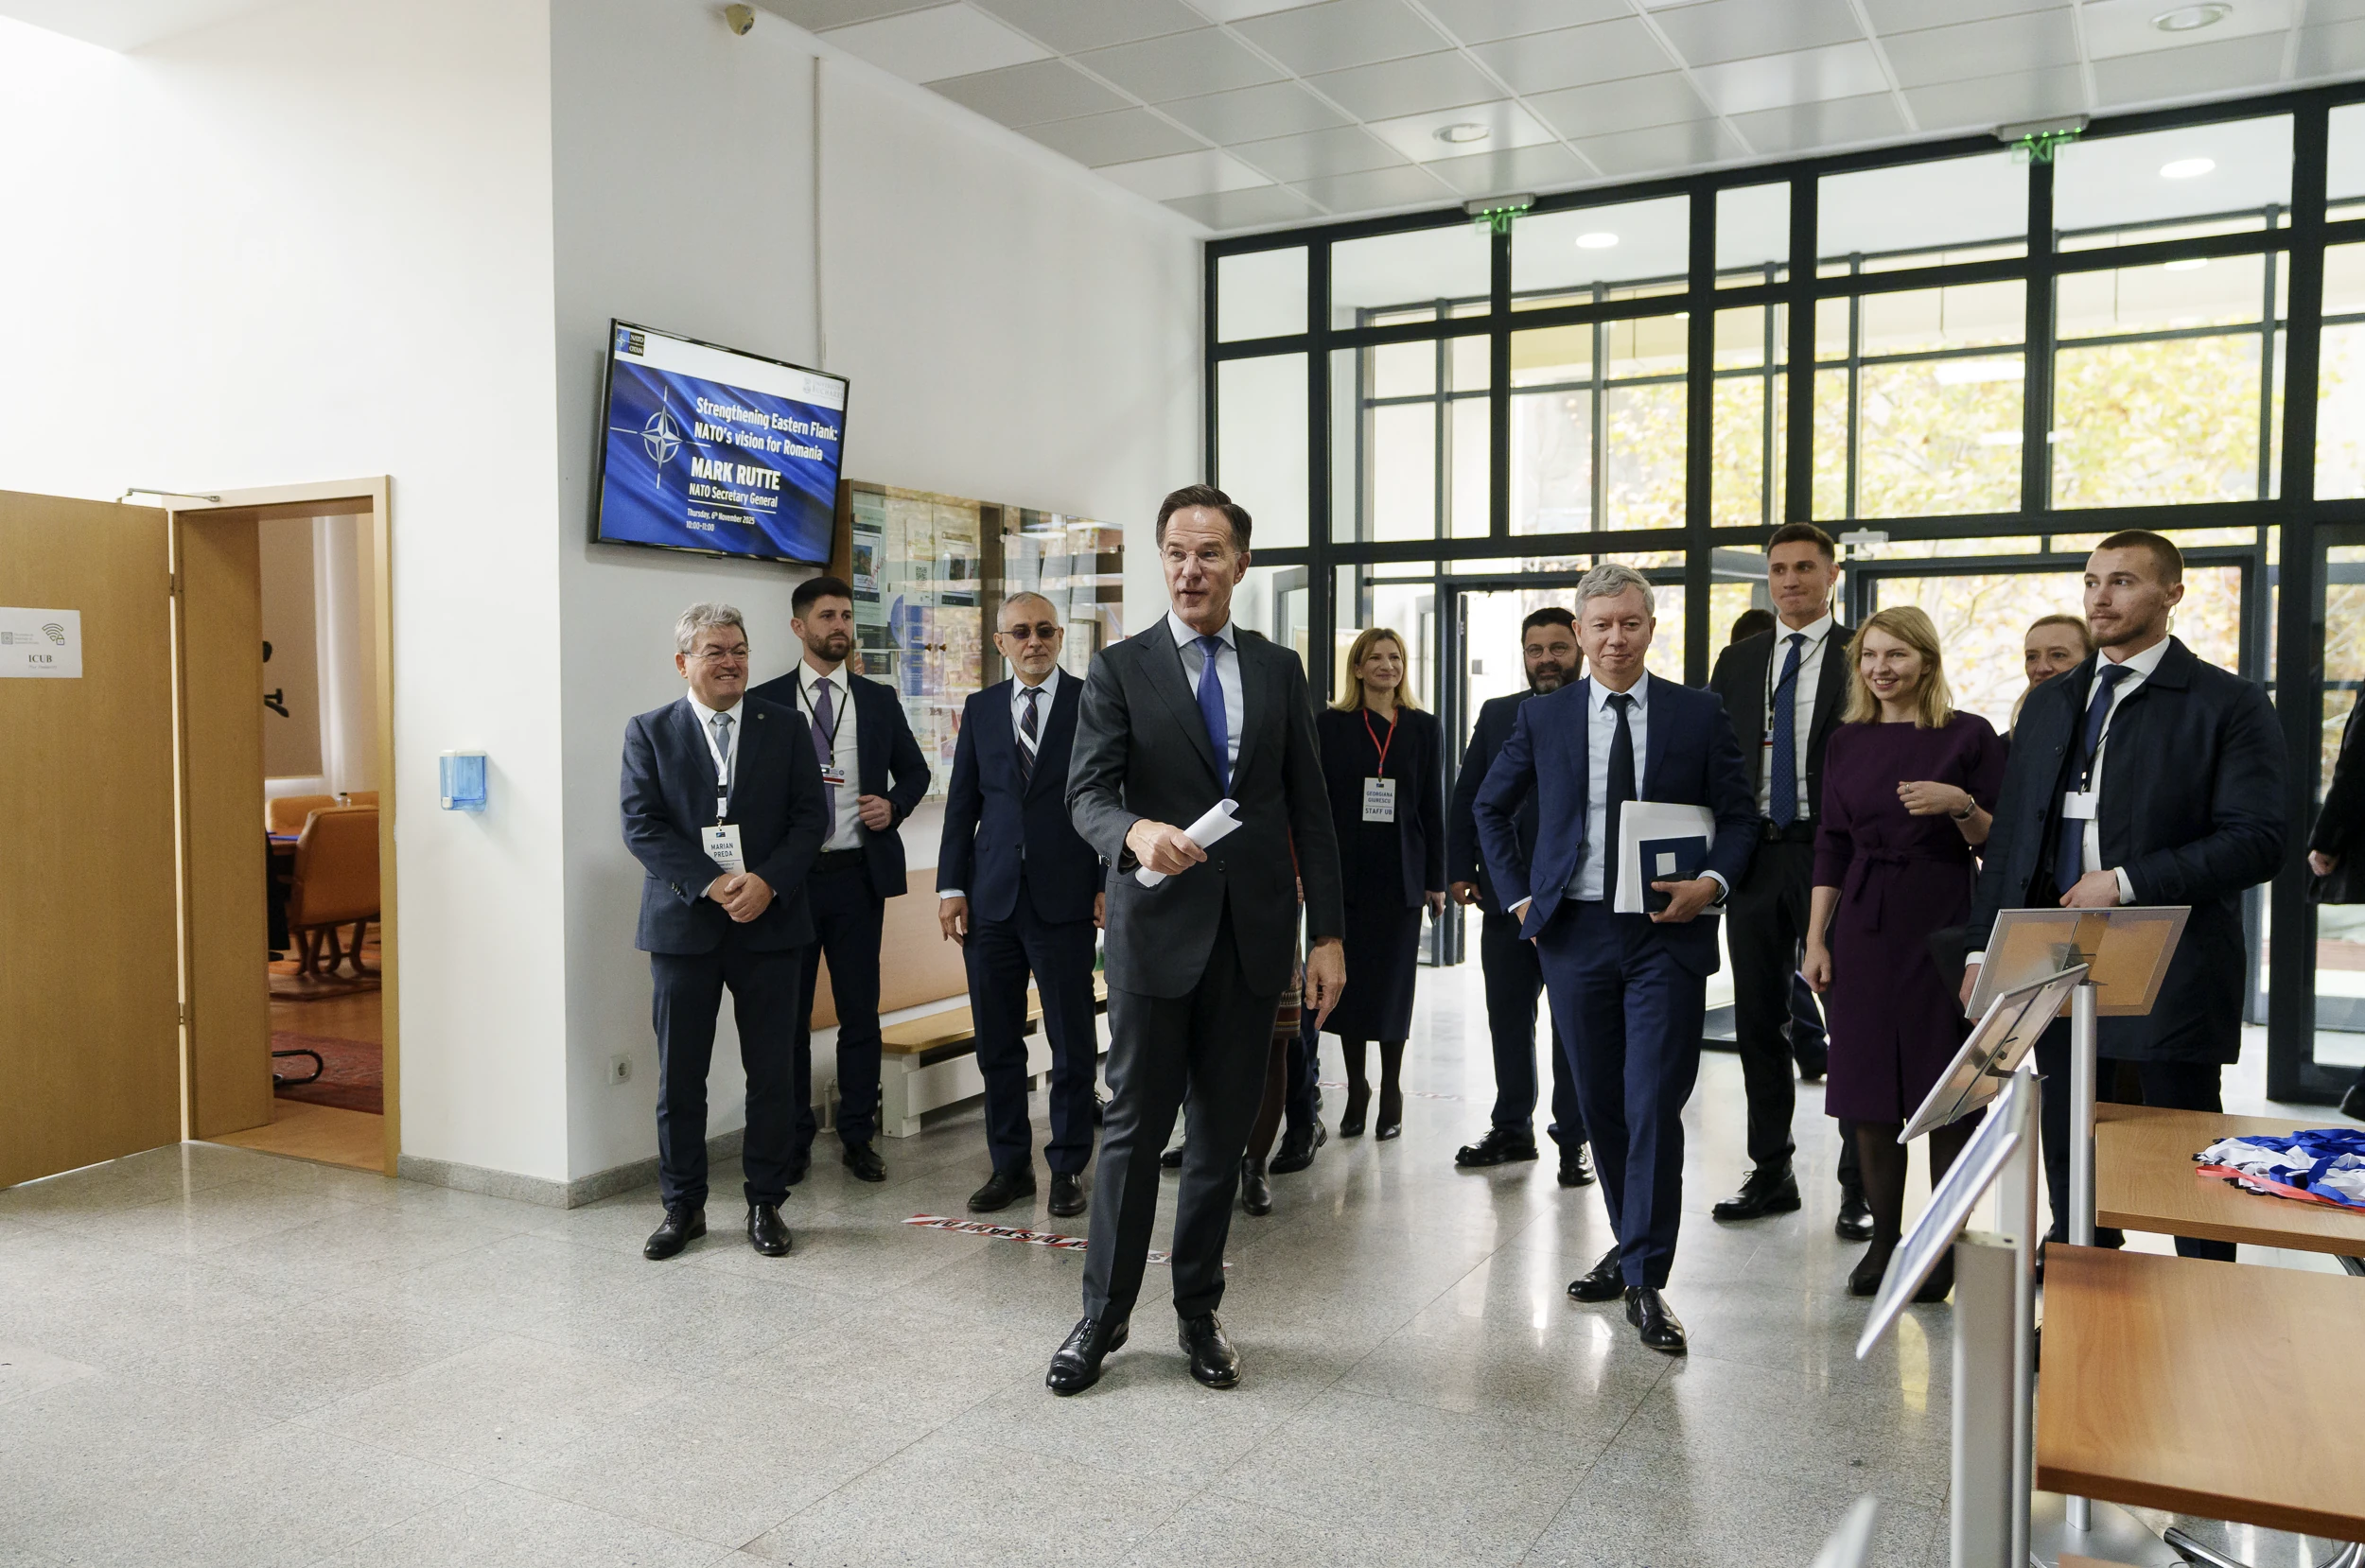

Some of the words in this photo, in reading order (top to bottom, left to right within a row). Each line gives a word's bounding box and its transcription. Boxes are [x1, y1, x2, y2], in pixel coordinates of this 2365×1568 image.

[2011, 135, 2073, 165] EXIT
[1475, 211, 1523, 235] EXIT
[630, 334, 644, 342] NATO
[696, 397, 770, 430] Strengthening
[772, 412, 809, 435] Eastern
[811, 421, 838, 442] Flank:
[694, 421, 732, 444] NATO's
[735, 429, 764, 450] vision
[766, 435, 782, 453] for
[783, 439, 823, 462] Romania
[691, 456, 733, 483] MARK
[736, 463, 781, 491] RUTTE
[689, 482, 710, 497] NATO
[711, 486, 749, 506] Secretary
[749, 492, 779, 508] General
[687, 508, 710, 520] Thursday,
[718, 513, 743, 523] November
[742, 515, 755, 525] 2025
[28, 654, 53, 663] ICUB
